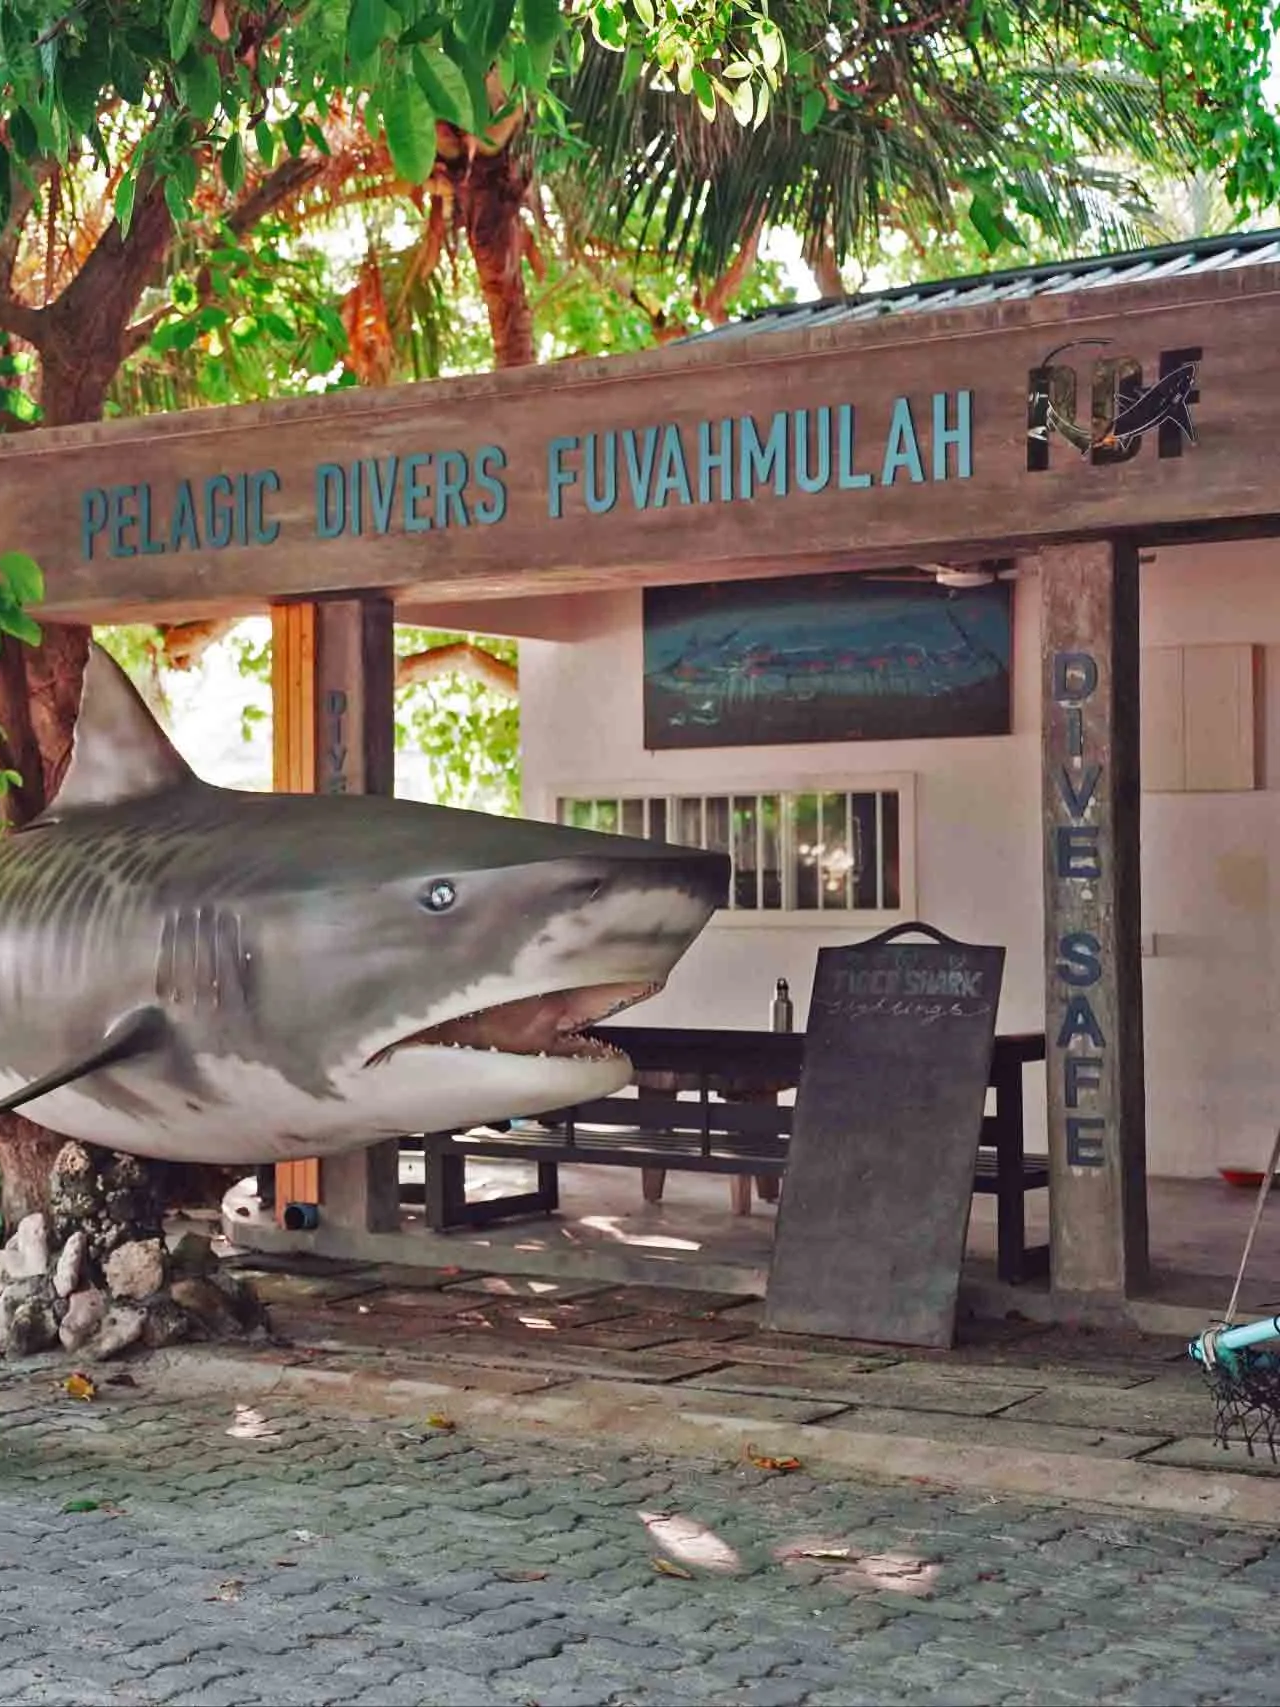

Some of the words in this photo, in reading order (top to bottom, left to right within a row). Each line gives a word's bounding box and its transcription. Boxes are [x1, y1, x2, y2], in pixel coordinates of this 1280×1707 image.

[81, 470, 282, 561] PELAGIC
[317, 444, 507, 539] DIVERS
[548, 389, 974, 518] FUVAHMULAH
[1053, 652, 1104, 880] DIVE
[1055, 931, 1108, 1168] SAFE
